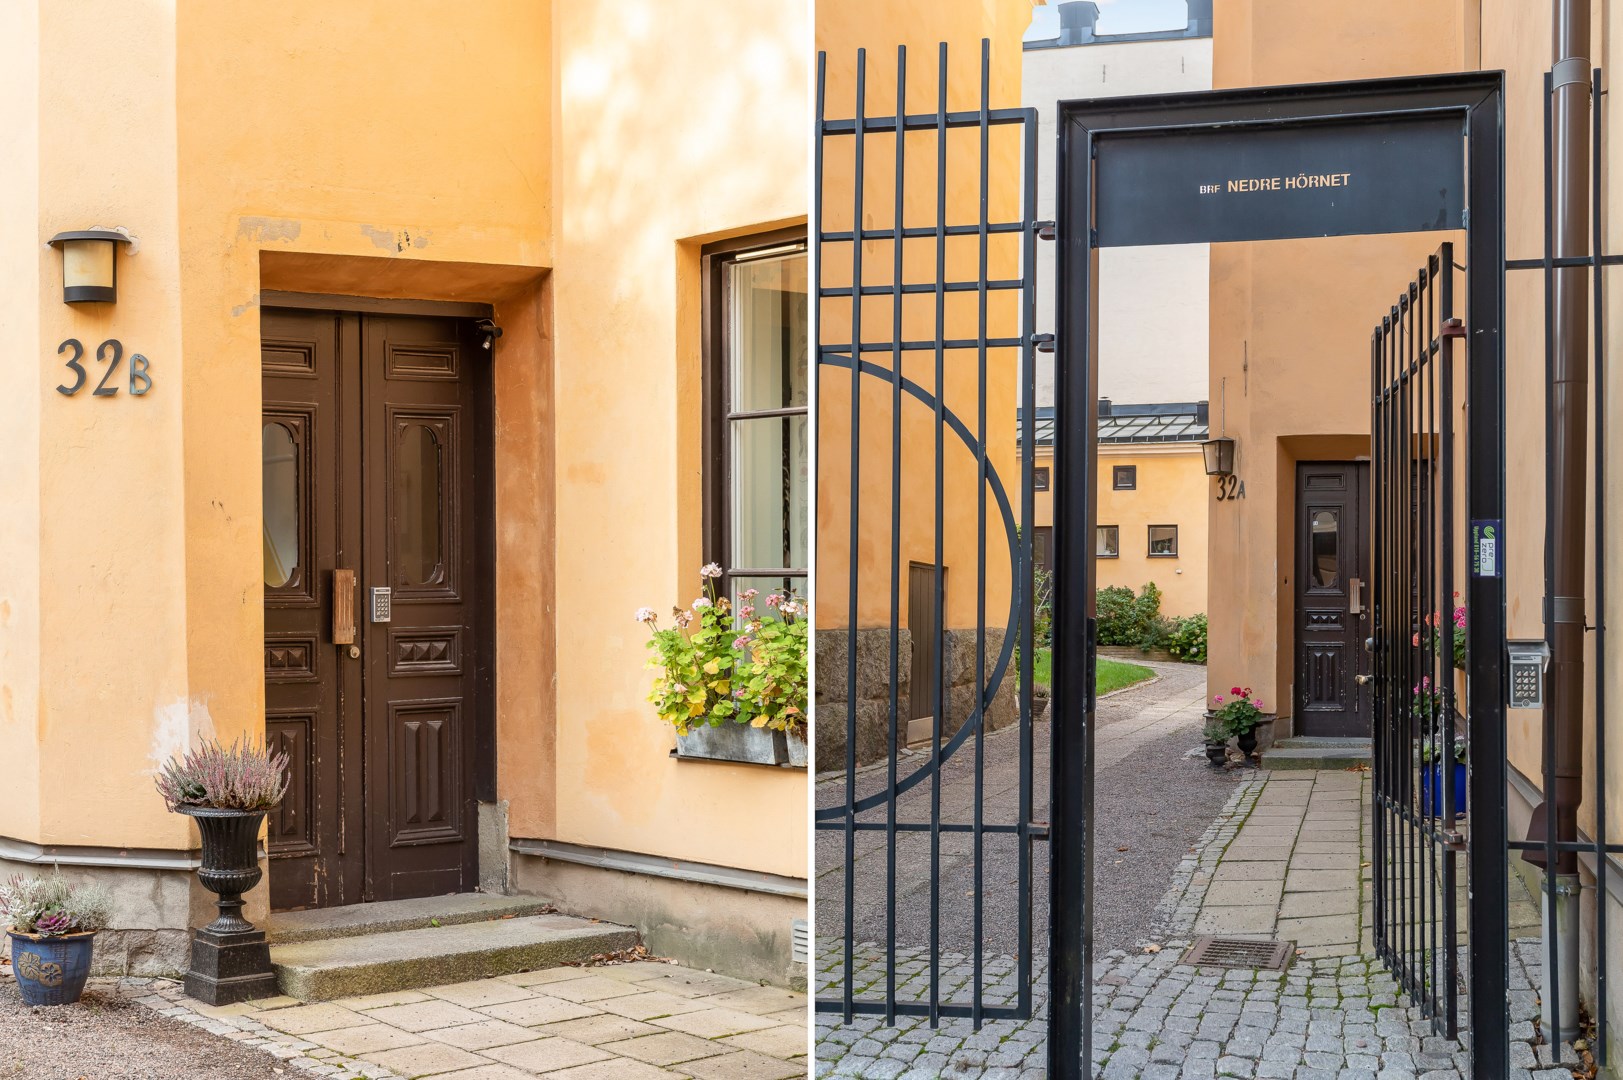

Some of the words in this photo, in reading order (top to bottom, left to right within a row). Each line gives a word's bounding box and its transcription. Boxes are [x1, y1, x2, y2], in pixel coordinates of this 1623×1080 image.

[1199, 184, 1221, 194] BRF
[1227, 177, 1281, 193] NEDRE
[1285, 173, 1351, 190] HÖRNET
[56, 338, 153, 396] 32B
[1216, 474, 1246, 502] 32A
